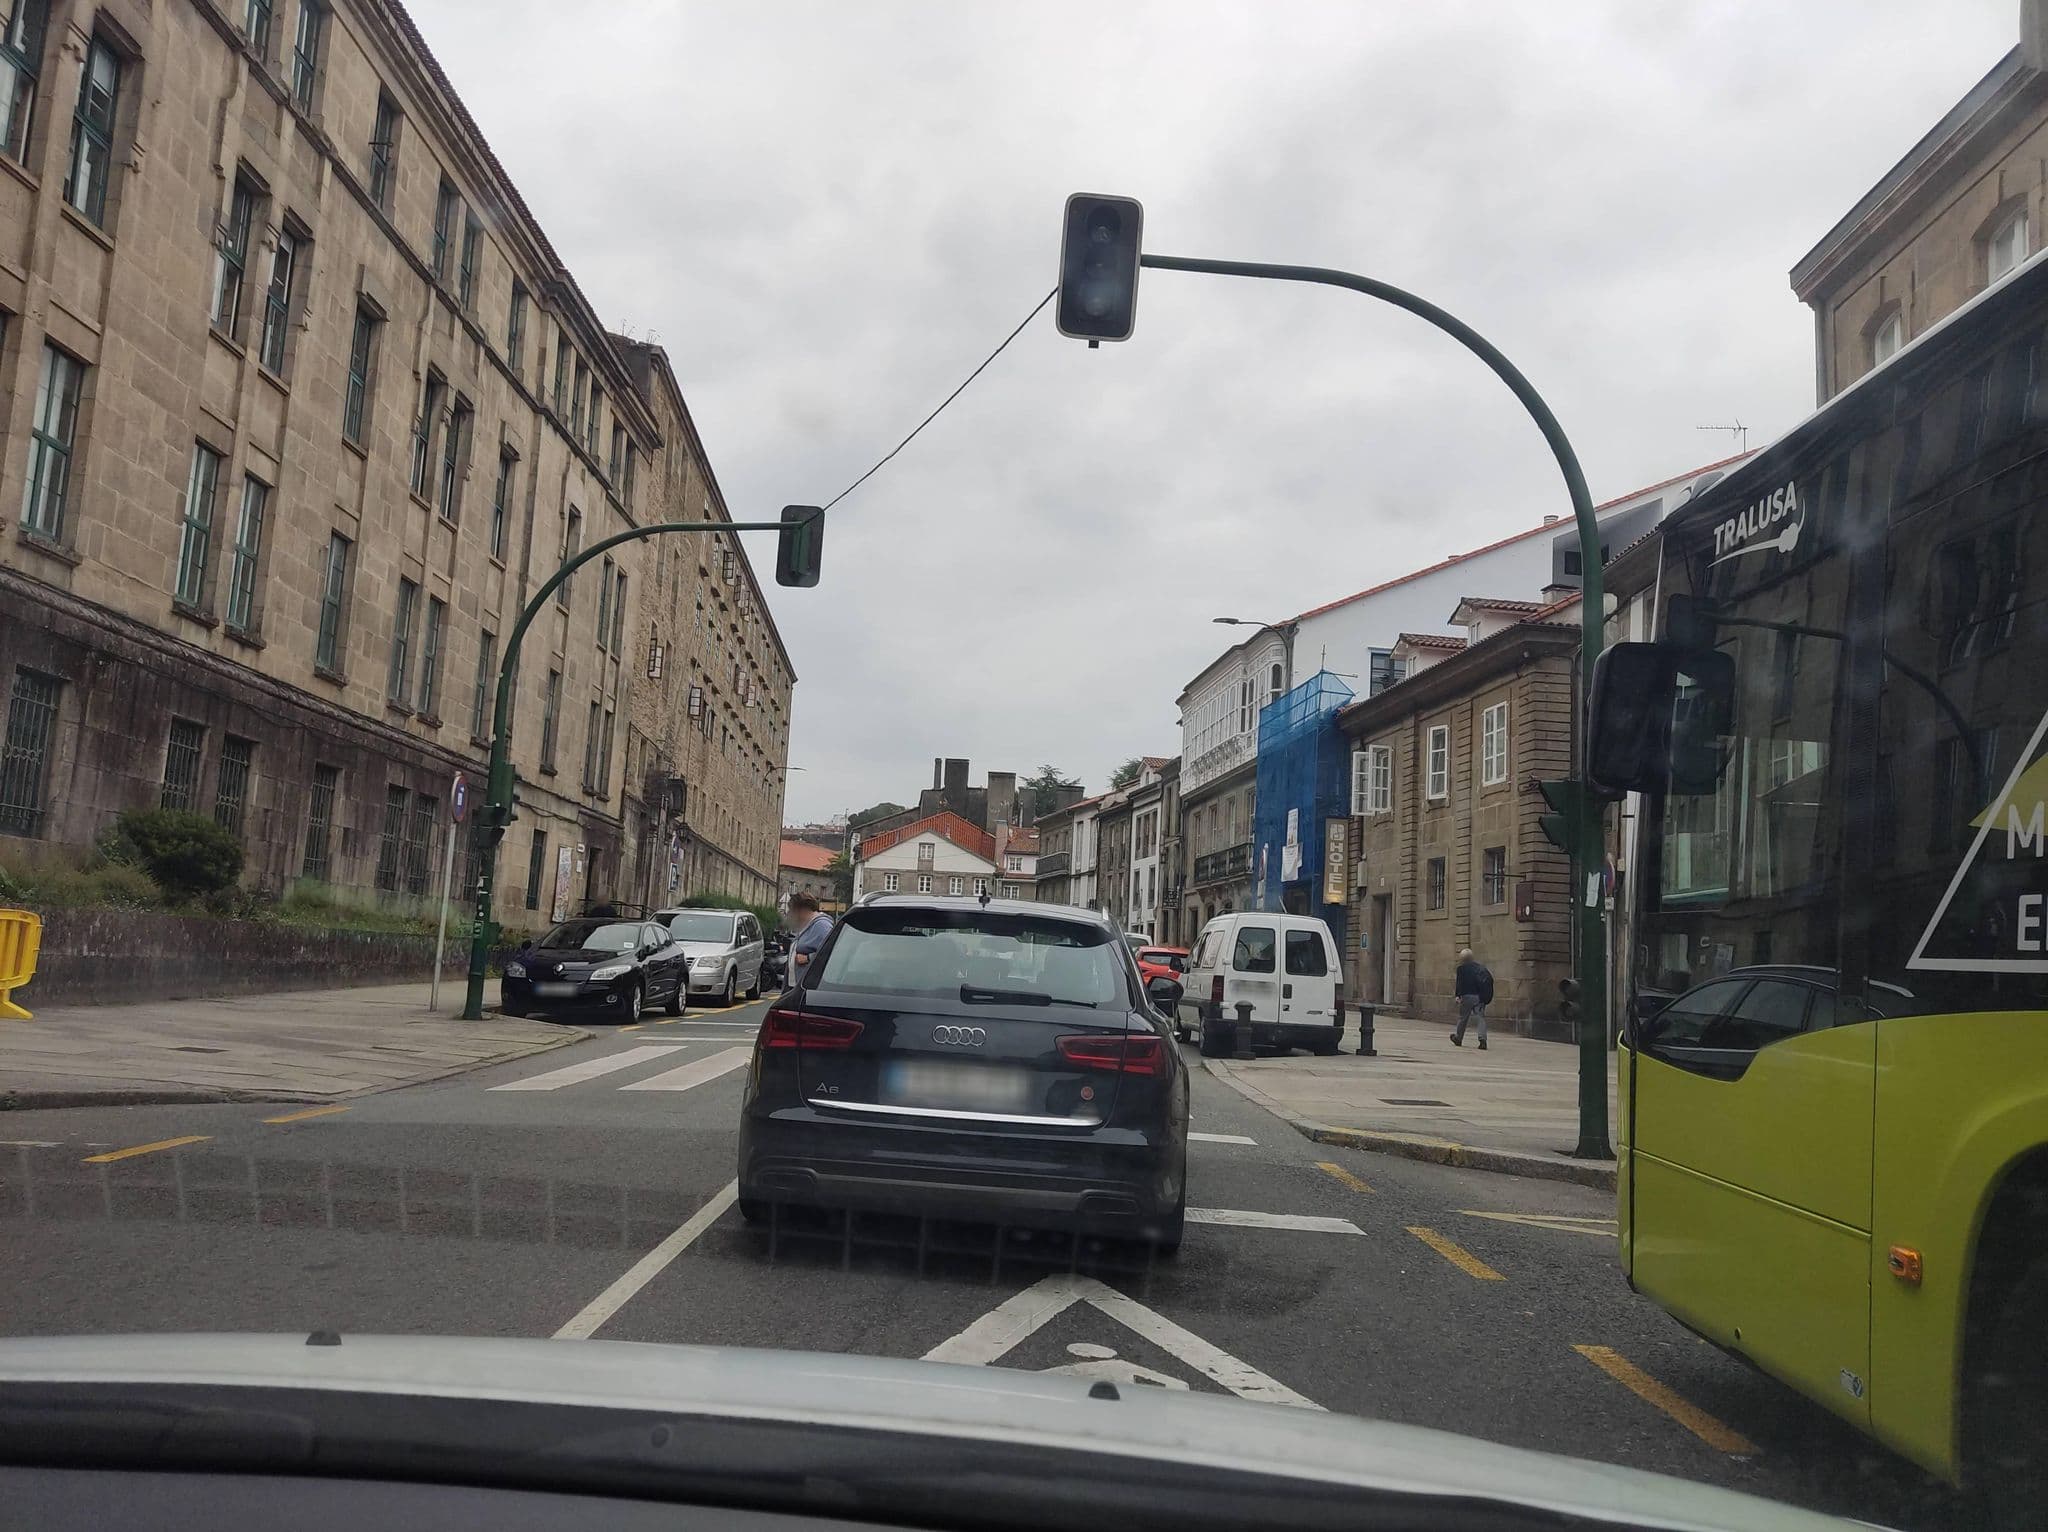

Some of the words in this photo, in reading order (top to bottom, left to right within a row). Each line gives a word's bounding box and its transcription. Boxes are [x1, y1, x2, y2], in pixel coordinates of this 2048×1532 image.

[1713, 481, 1797, 556] TRALUSA
[1328, 841, 1344, 894] HOTEL
[2017, 894, 2048, 951] E
[815, 1082, 839, 1094] A6
